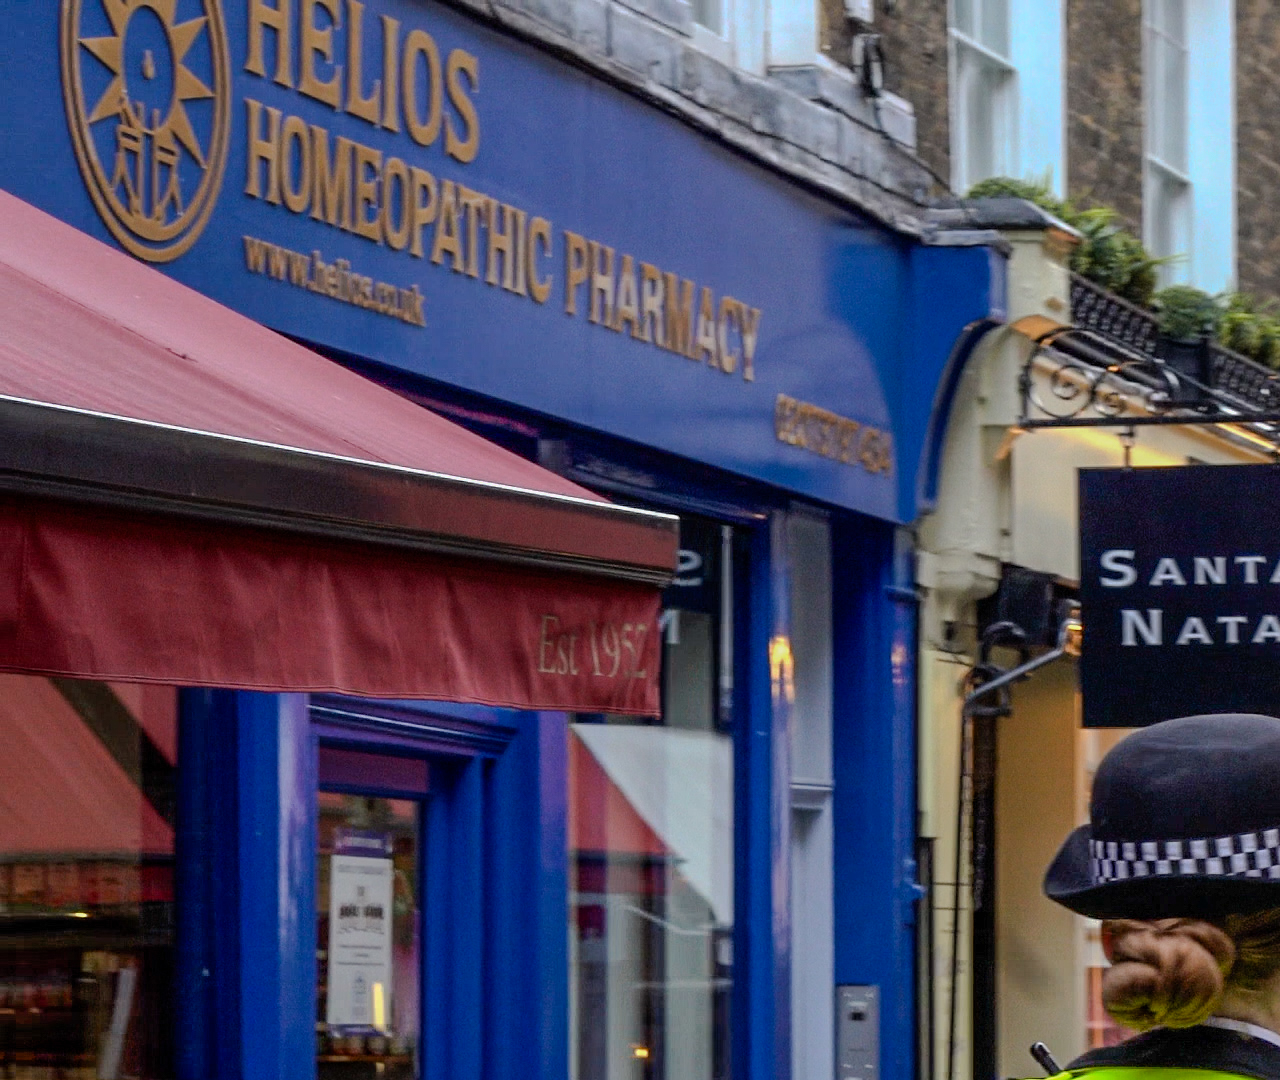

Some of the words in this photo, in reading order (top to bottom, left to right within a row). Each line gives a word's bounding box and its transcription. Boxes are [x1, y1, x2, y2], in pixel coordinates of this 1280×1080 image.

[244, 0, 479, 163] HELIOS
[244, 98, 552, 305] HOMEOPATHIC
[564, 229, 760, 382] PHARMACY
[537, 614, 579, 677] Est
